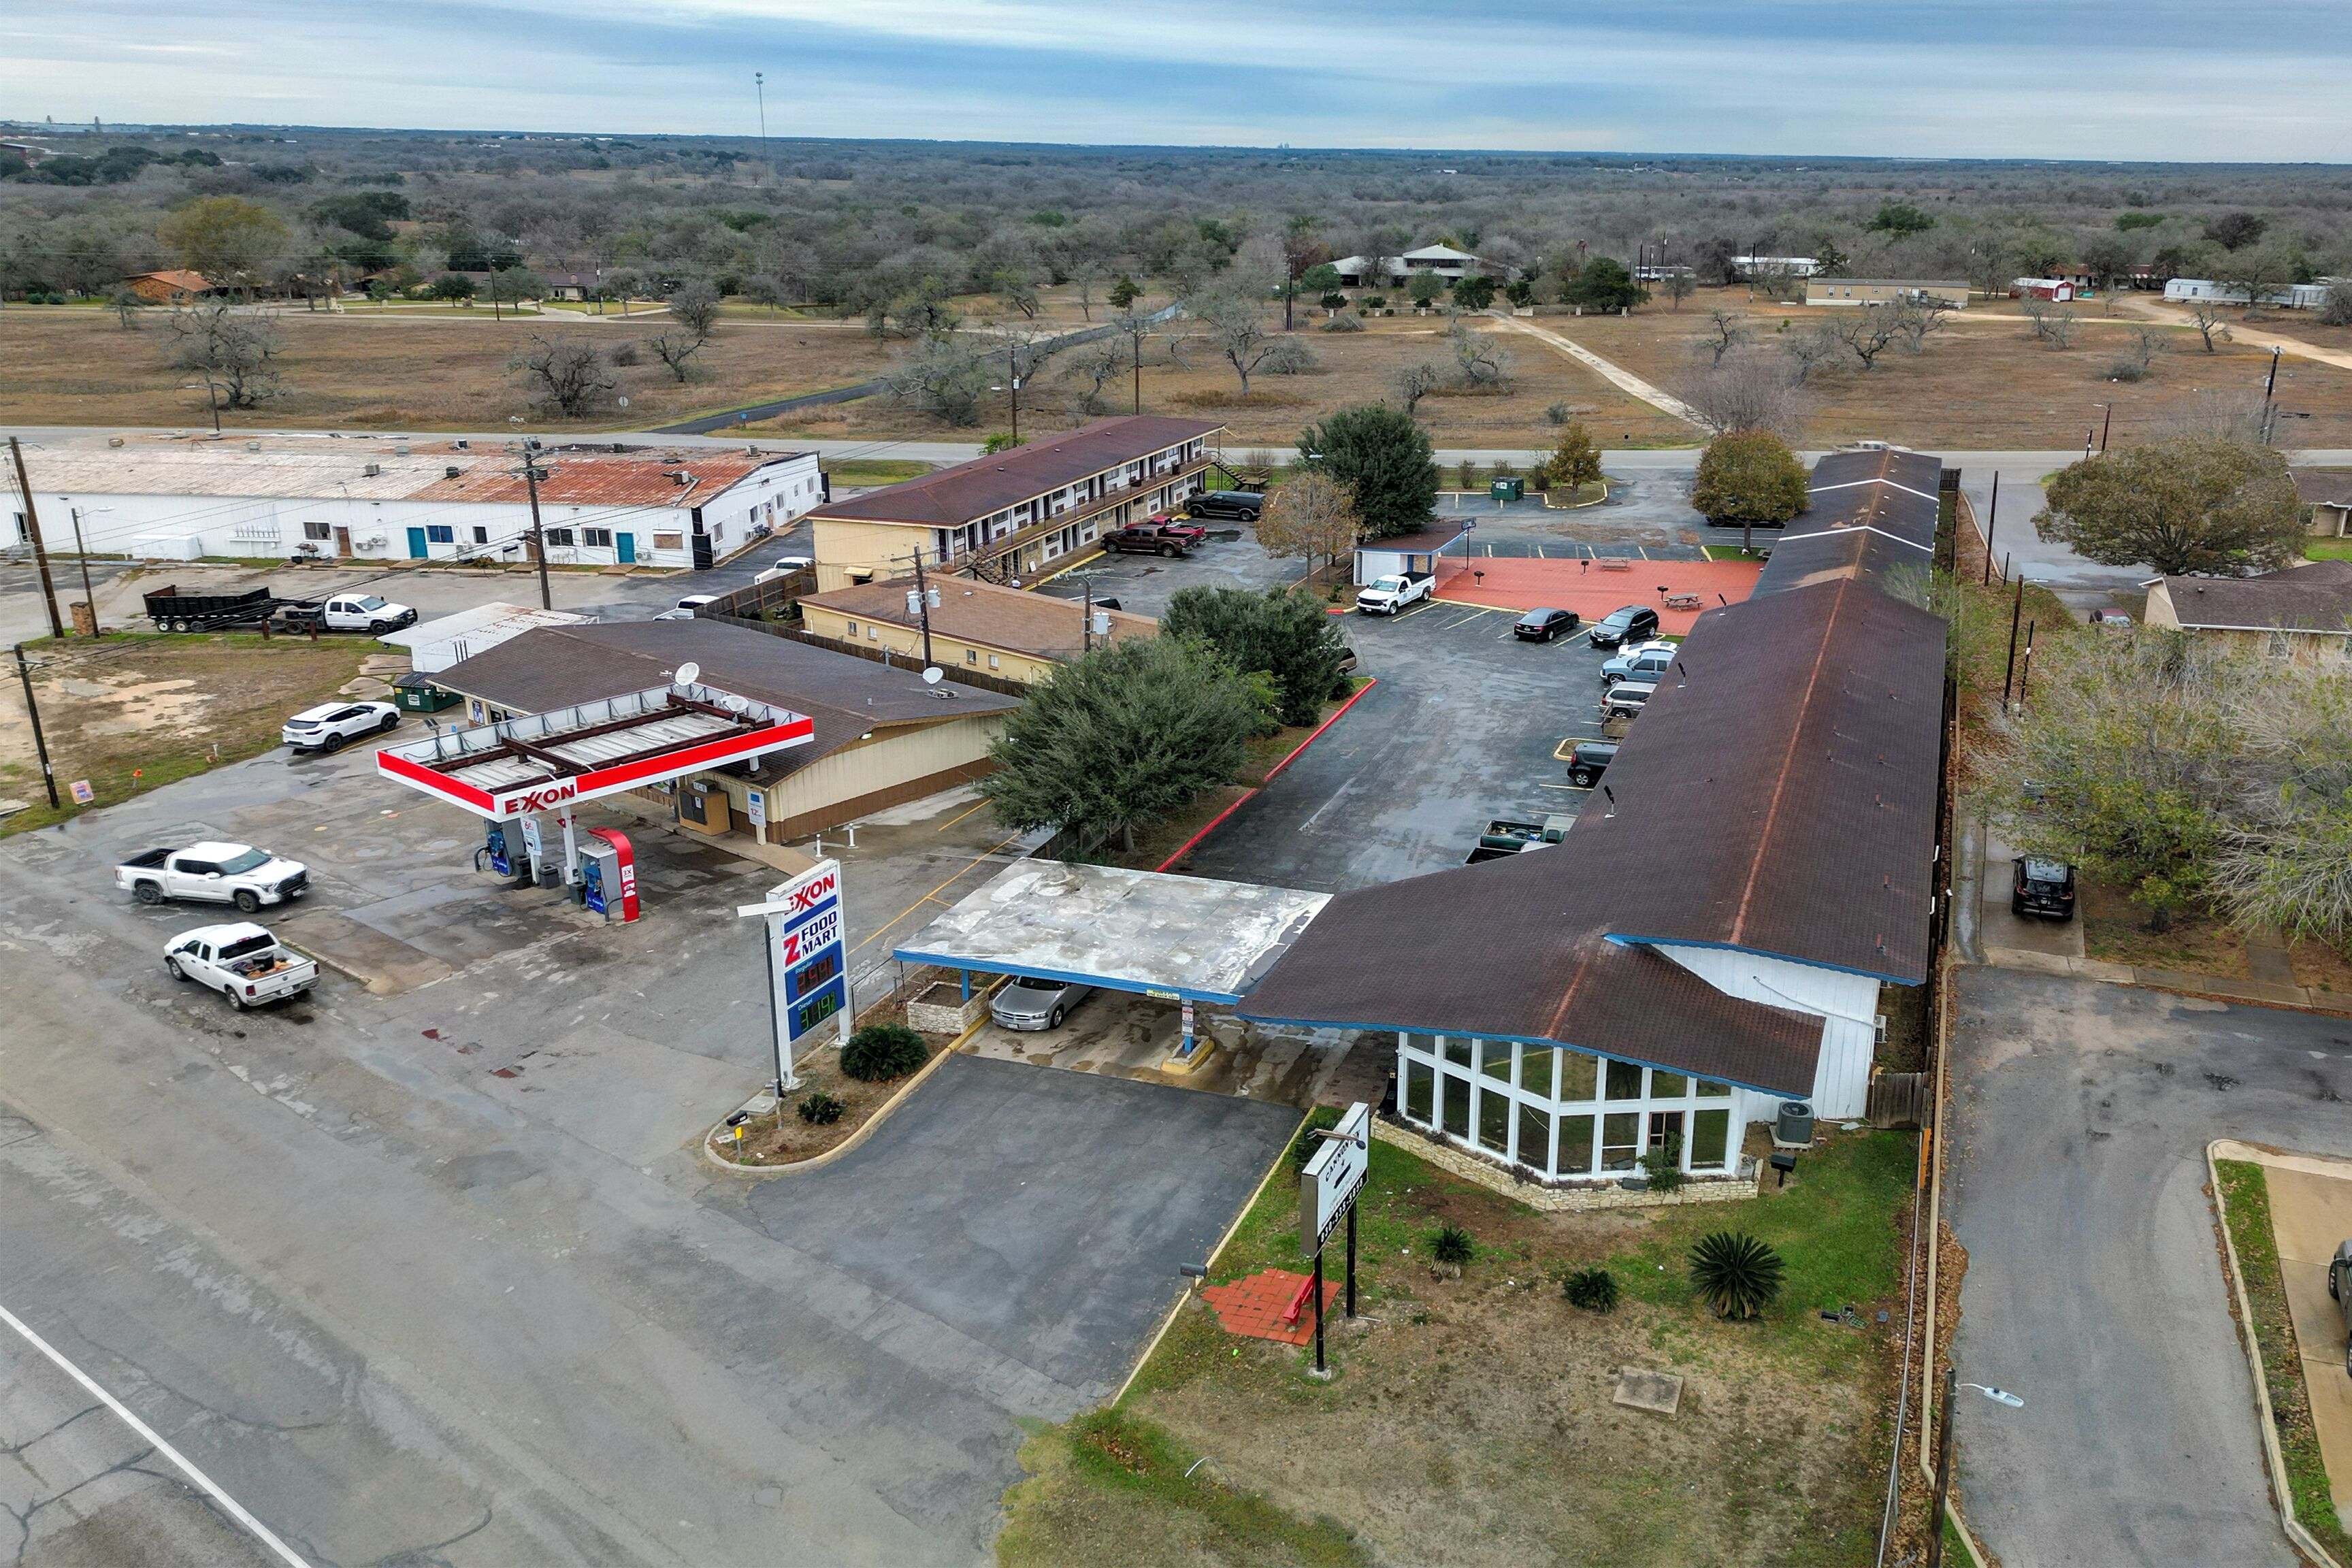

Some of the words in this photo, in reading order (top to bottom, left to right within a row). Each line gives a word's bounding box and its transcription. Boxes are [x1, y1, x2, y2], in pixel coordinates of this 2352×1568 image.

[504, 784, 576, 815] EXXON
[694, 783, 706, 791] ICE
[802, 911, 837, 942] FOOD
[802, 925, 837, 957] MART
[783, 933, 800, 968] Z
